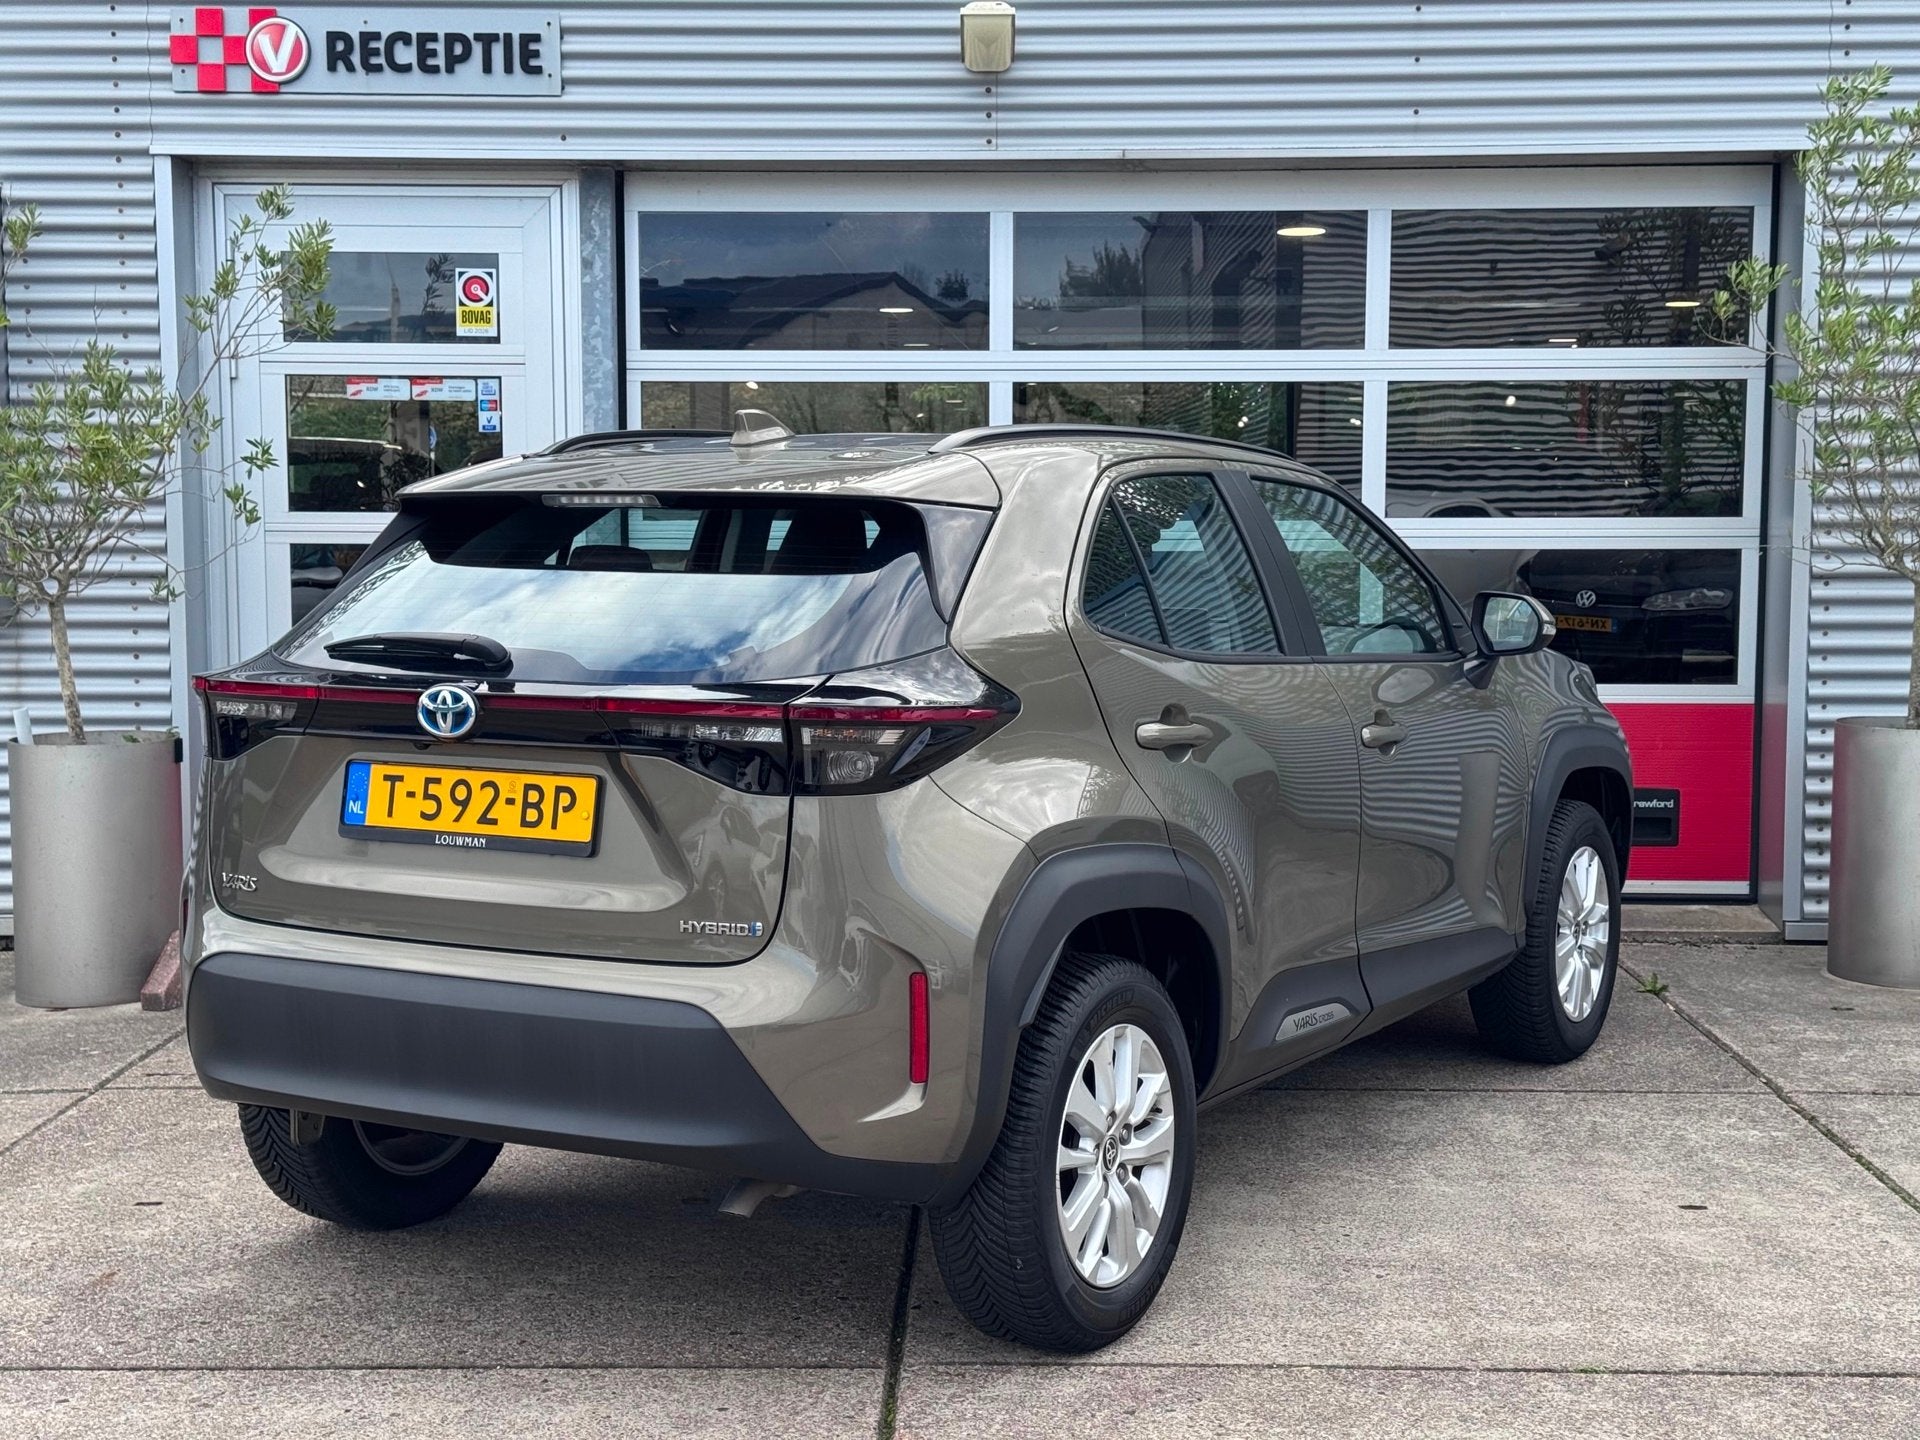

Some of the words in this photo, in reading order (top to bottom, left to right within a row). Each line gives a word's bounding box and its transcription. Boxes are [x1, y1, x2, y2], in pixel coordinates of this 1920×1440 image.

[325, 30, 544, 75] RECEPTIE
[461, 309, 491, 325] BOVAG
[348, 799, 364, 815] NL
[382, 773, 577, 830] T-592-BP
[1633, 798, 1674, 808] rawford
[435, 834, 487, 848] LOUWMAN
[679, 919, 749, 936] HYBRID
[1293, 1012, 1318, 1031] YARIS
